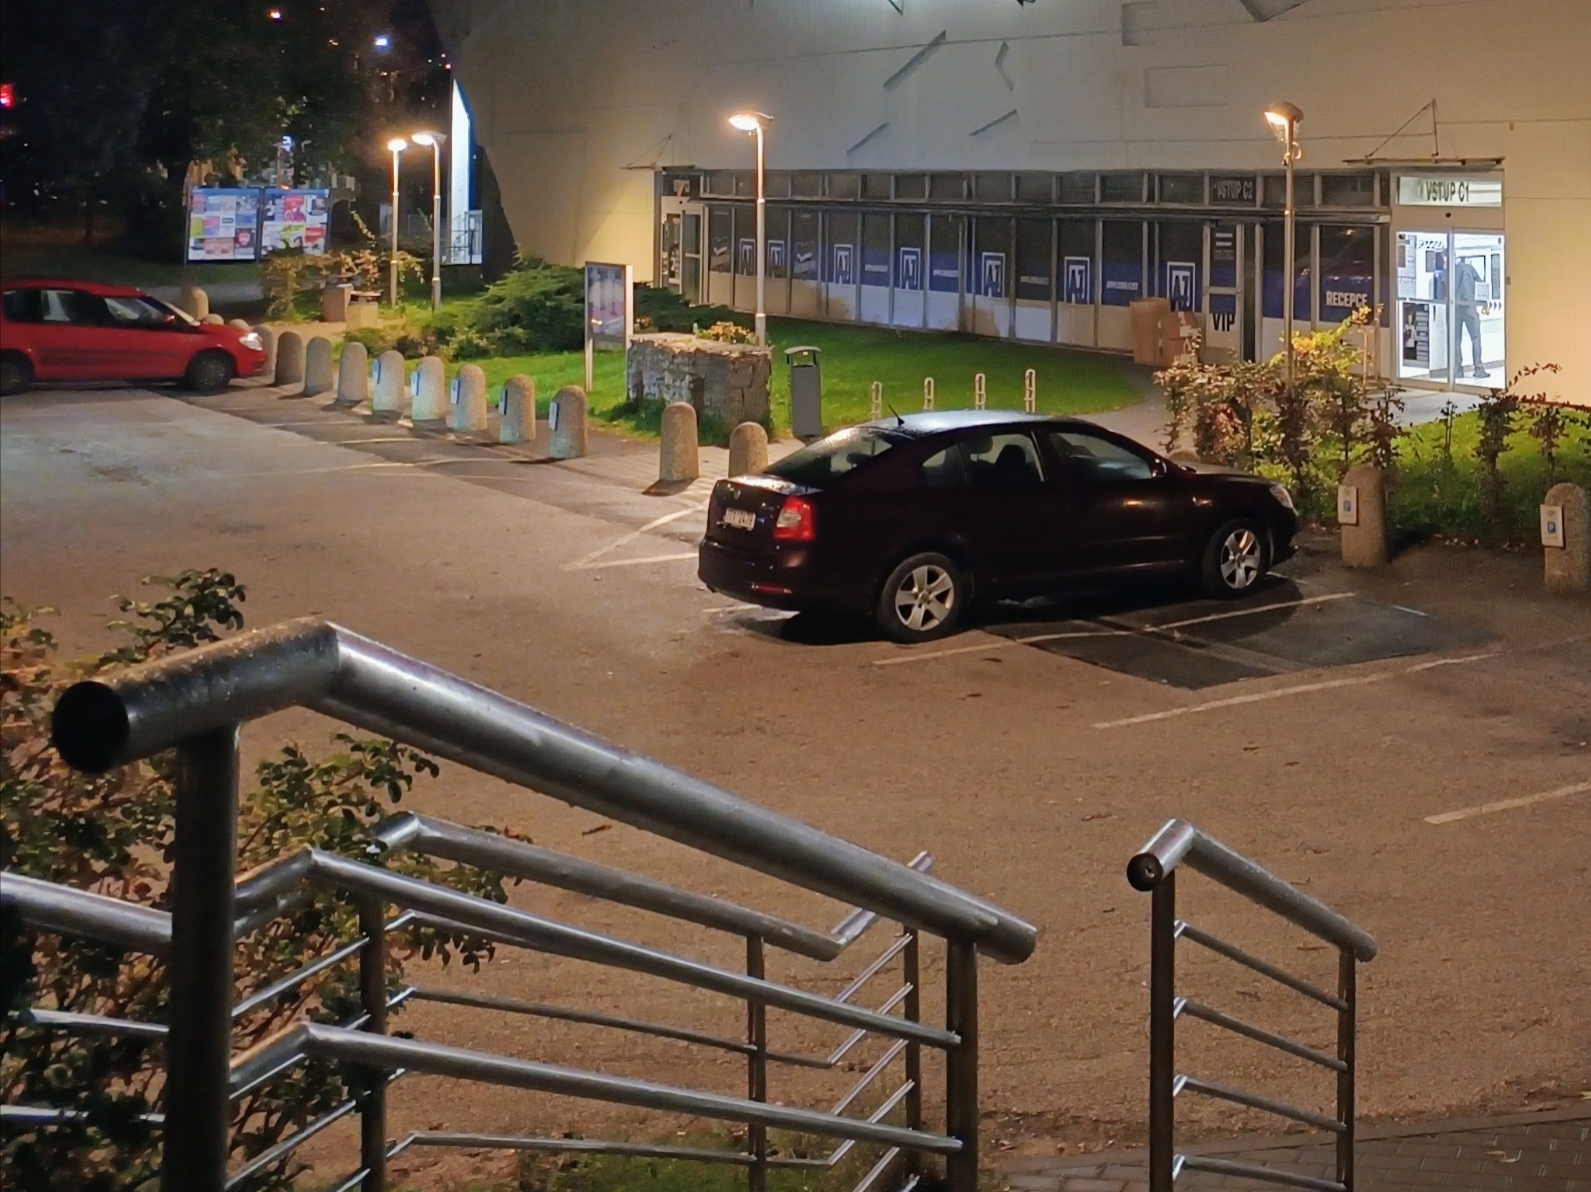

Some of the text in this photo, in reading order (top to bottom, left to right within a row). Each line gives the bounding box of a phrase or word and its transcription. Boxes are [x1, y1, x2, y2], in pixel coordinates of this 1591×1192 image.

[1216, 180, 1254, 199] VSTUP C2
[1425, 180, 1469, 202] VSTUP C1
[1326, 291, 1368, 308] RECEPCE
[1213, 313, 1236, 331] VIP
